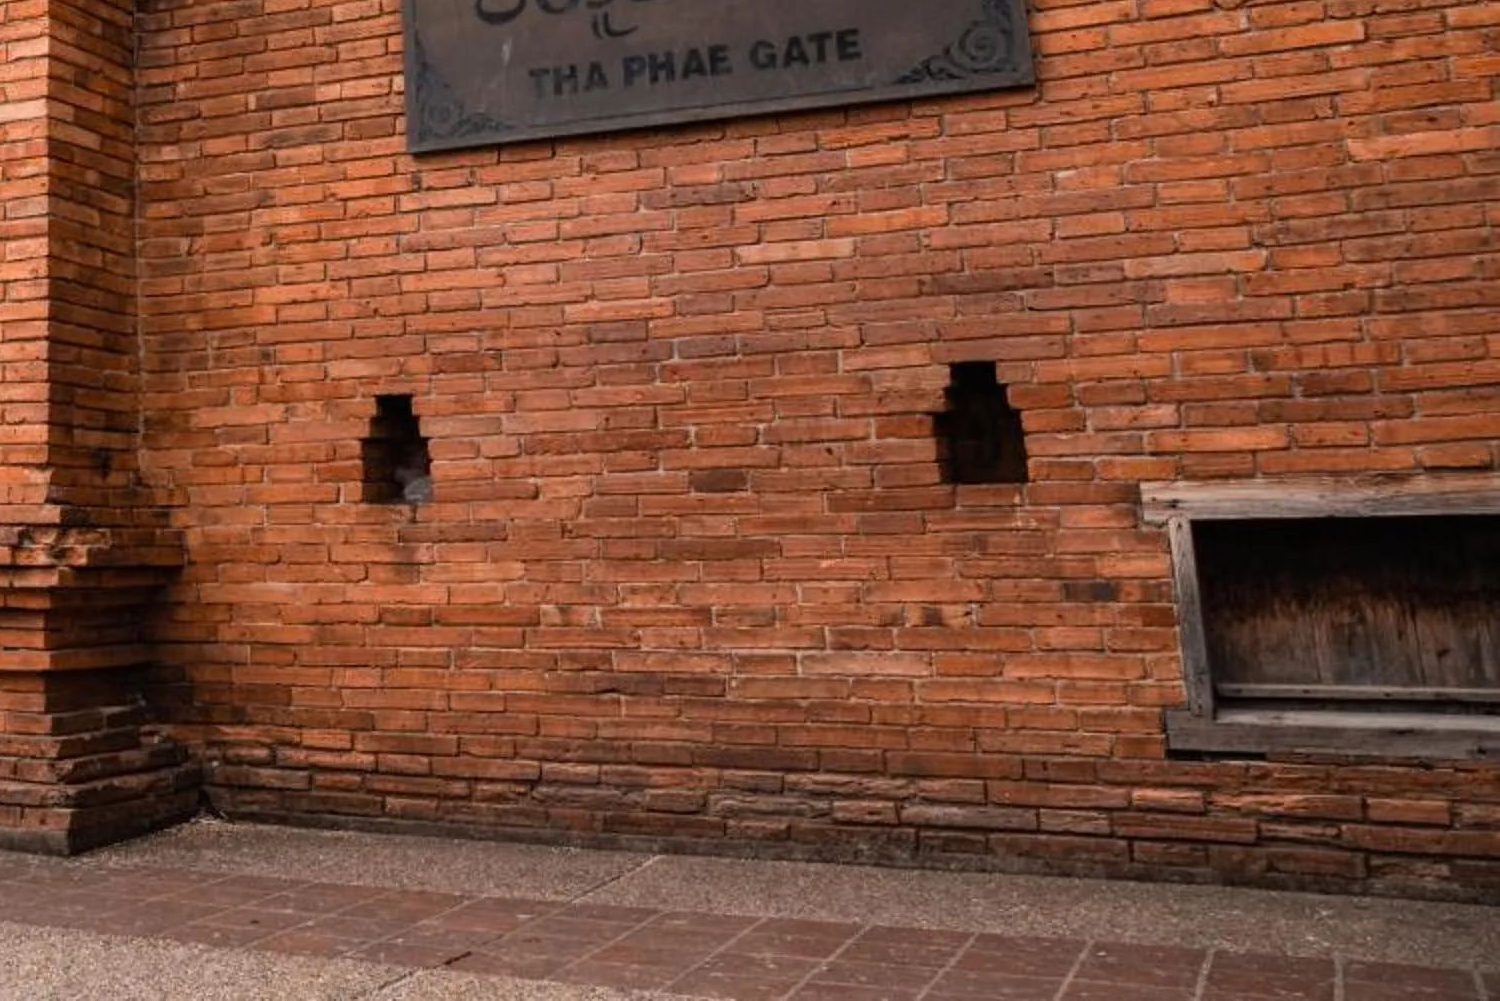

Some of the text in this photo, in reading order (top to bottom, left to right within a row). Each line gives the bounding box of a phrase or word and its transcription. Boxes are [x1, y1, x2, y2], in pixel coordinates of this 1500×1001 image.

[529, 28, 862, 98] THA PHAE GATE
